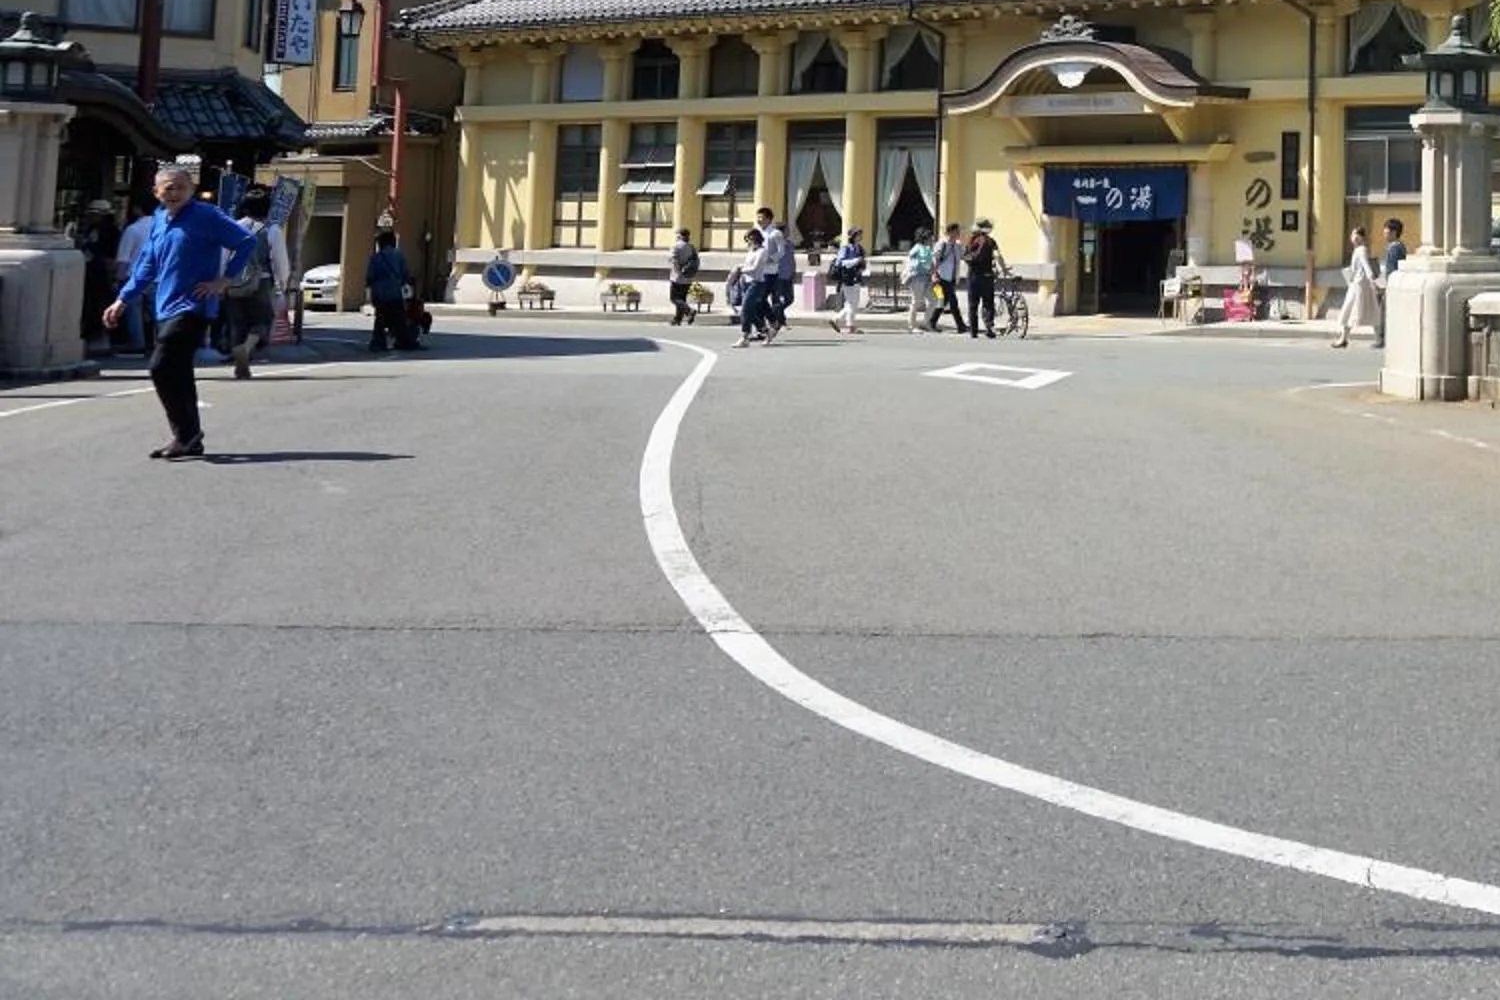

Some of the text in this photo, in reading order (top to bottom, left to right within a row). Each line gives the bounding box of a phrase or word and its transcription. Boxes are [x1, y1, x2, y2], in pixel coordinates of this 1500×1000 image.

[1076, 184, 1152, 211] 一の湯
[1242, 150, 1276, 252] 一の湯
